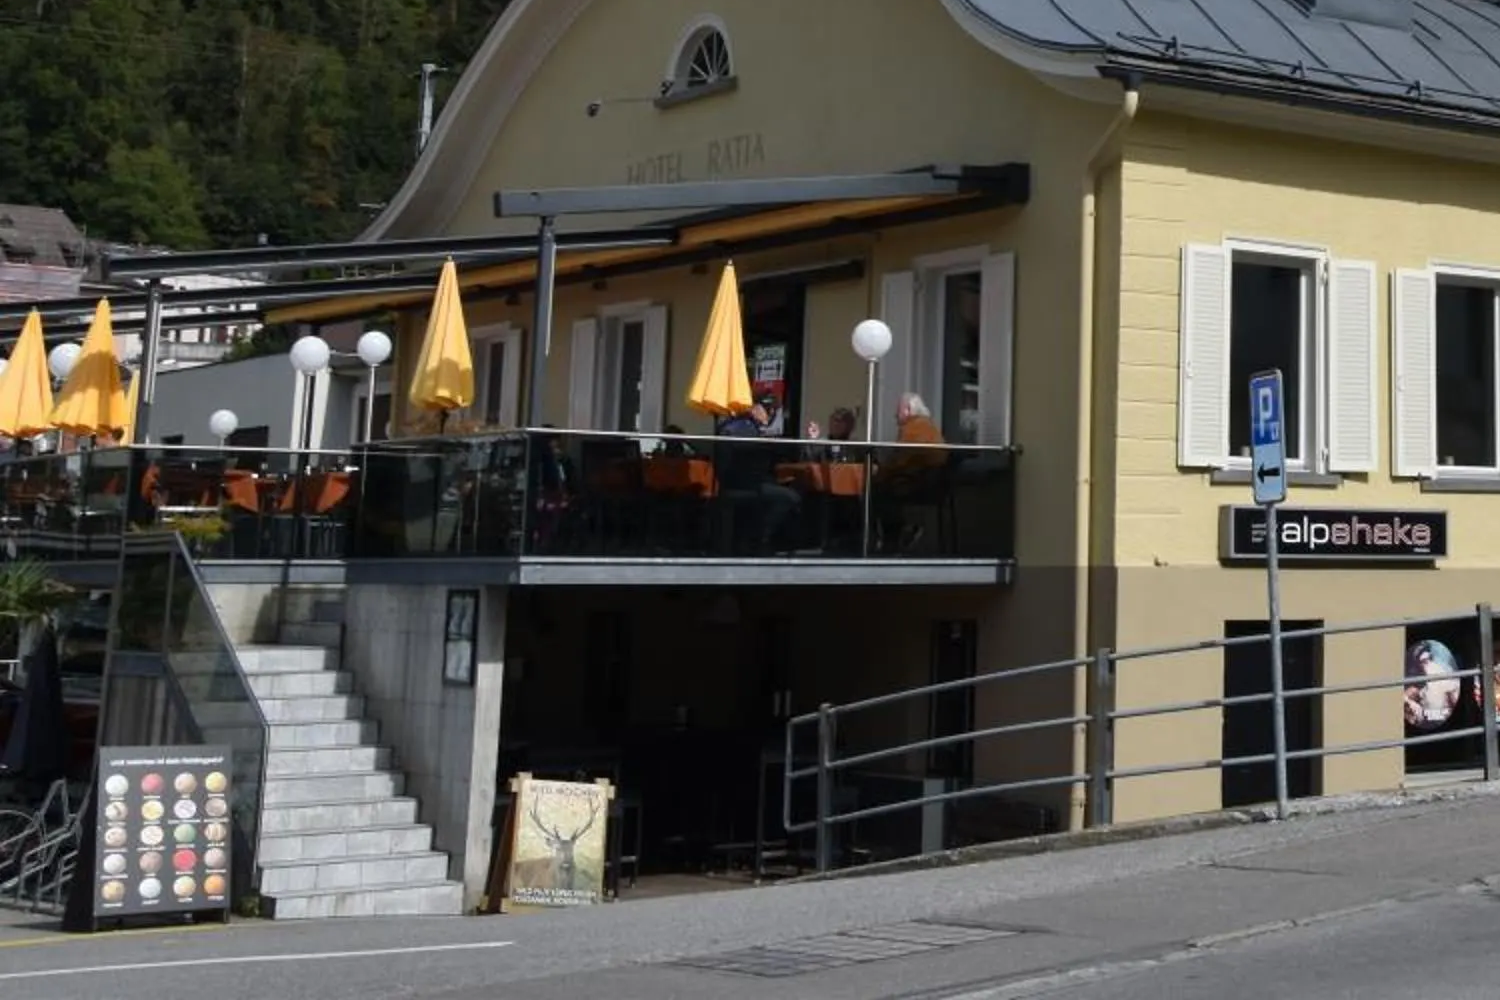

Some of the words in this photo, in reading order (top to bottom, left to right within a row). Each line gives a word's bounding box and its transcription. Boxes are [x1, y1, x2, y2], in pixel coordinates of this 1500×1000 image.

[627, 152, 687, 185] HOTEL
[1259, 387, 1273, 437] P
[1281, 515, 1431, 549] alpshake
